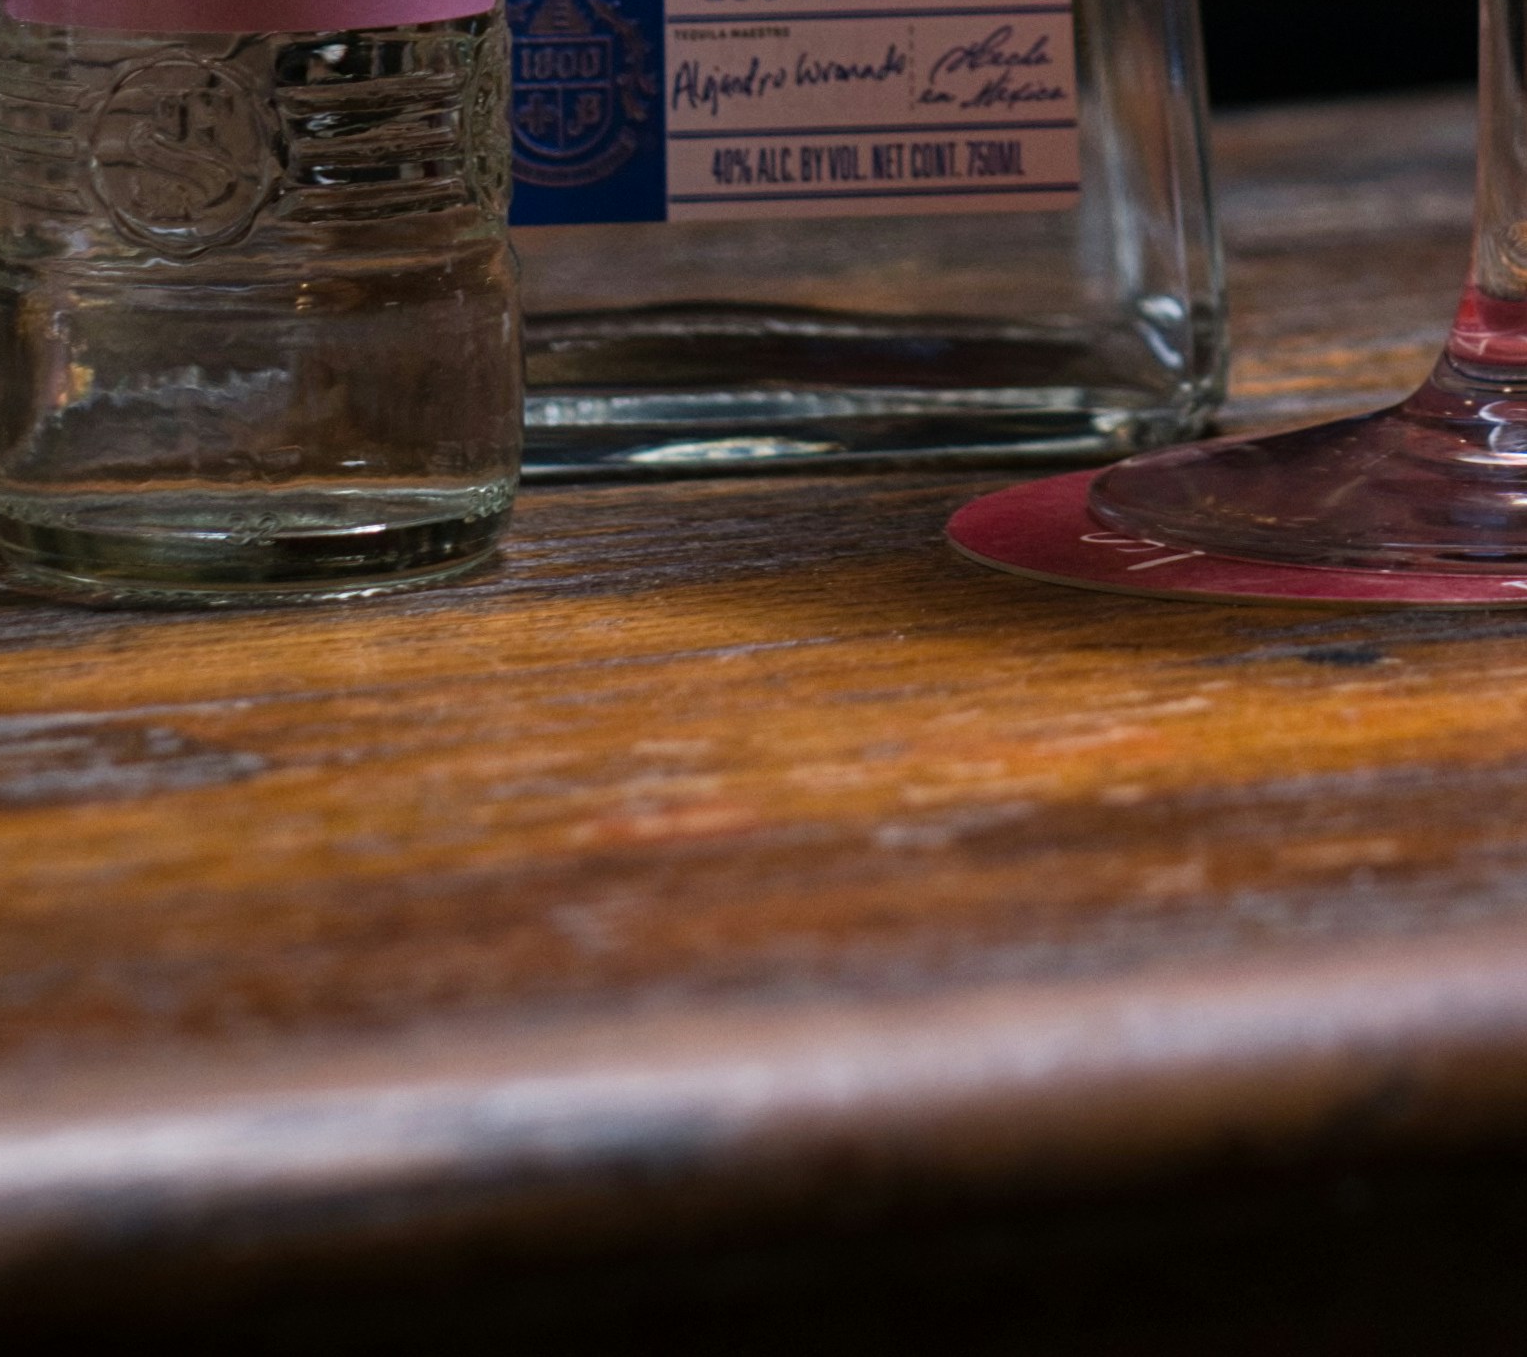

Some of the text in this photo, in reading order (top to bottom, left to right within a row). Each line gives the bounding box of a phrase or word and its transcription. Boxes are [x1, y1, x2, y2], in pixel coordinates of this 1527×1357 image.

[674, 26, 791, 42] TEQUILA MAESTRO
[712, 140, 1025, 184] 40% ALC. BY VOL. NET CONT. 750ML
